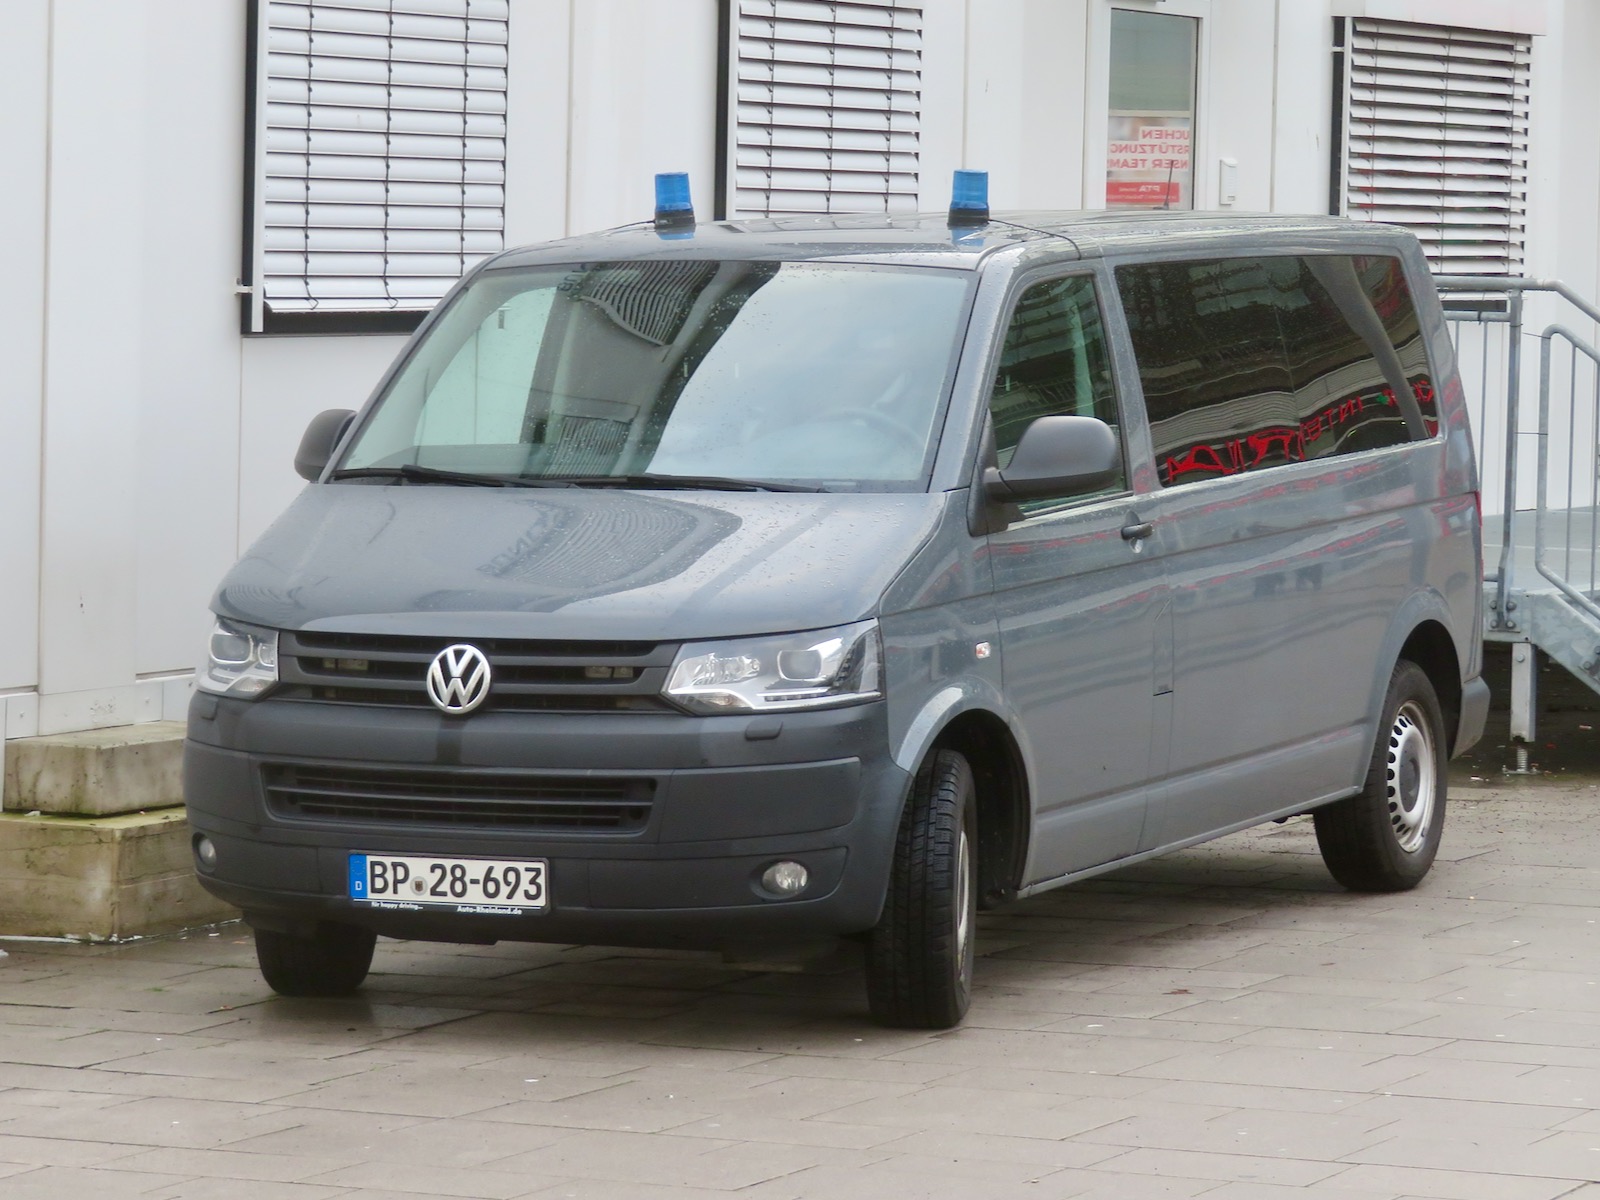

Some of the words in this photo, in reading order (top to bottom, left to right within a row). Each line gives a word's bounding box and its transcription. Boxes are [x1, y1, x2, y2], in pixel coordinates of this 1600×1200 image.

[354, 880, 363, 891] D
[369, 860, 410, 895] BP
[430, 863, 543, 901] 28-693
